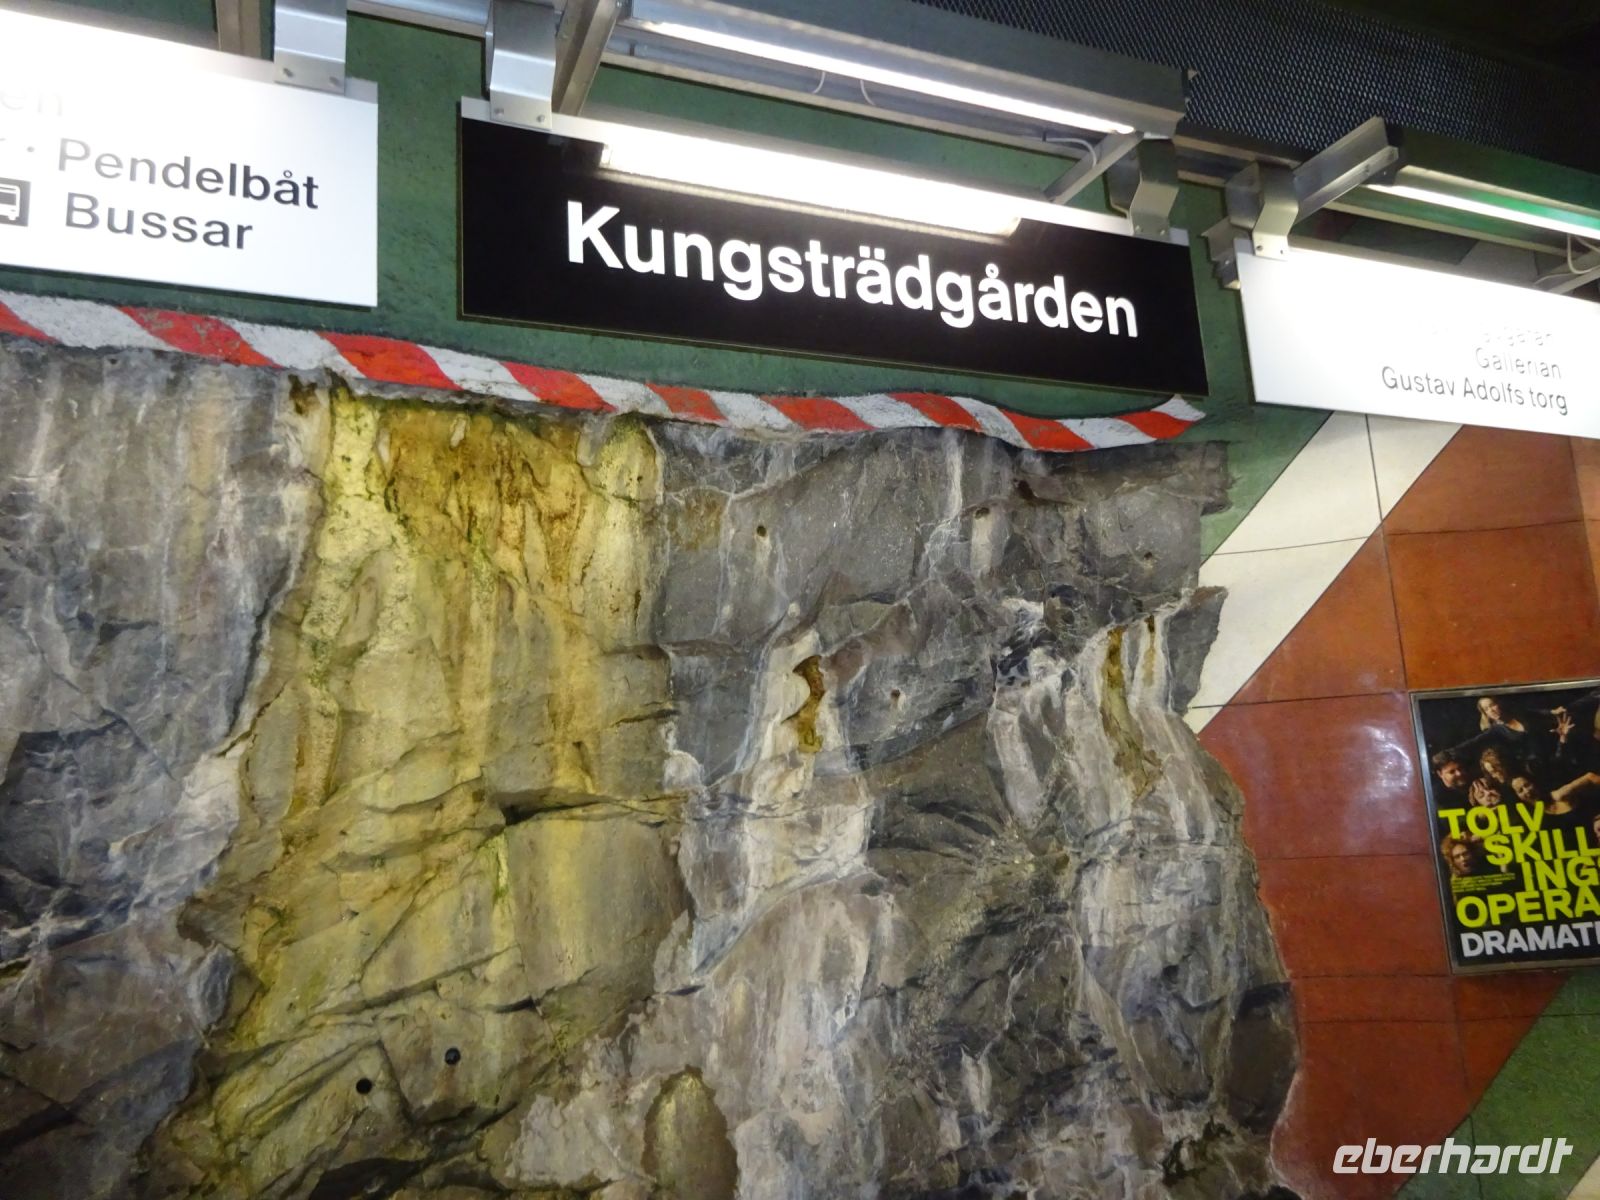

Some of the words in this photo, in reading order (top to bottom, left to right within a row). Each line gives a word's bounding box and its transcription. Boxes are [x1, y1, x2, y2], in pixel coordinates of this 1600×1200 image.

[57, 136, 319, 210] Pendelbåt
[65, 192, 253, 249] Bussar
[566, 199, 1139, 338] Kungsträdgården
[1381, 365, 1456, 396] Gustav
[1463, 376, 1525, 406] Adolfs
[1529, 387, 1569, 416] torg
[1438, 801, 1545, 840] TOLV
[1484, 827, 1600, 866] SKILL
[1522, 856, 1600, 892] ING
[1455, 885, 1600, 928] OPERA
